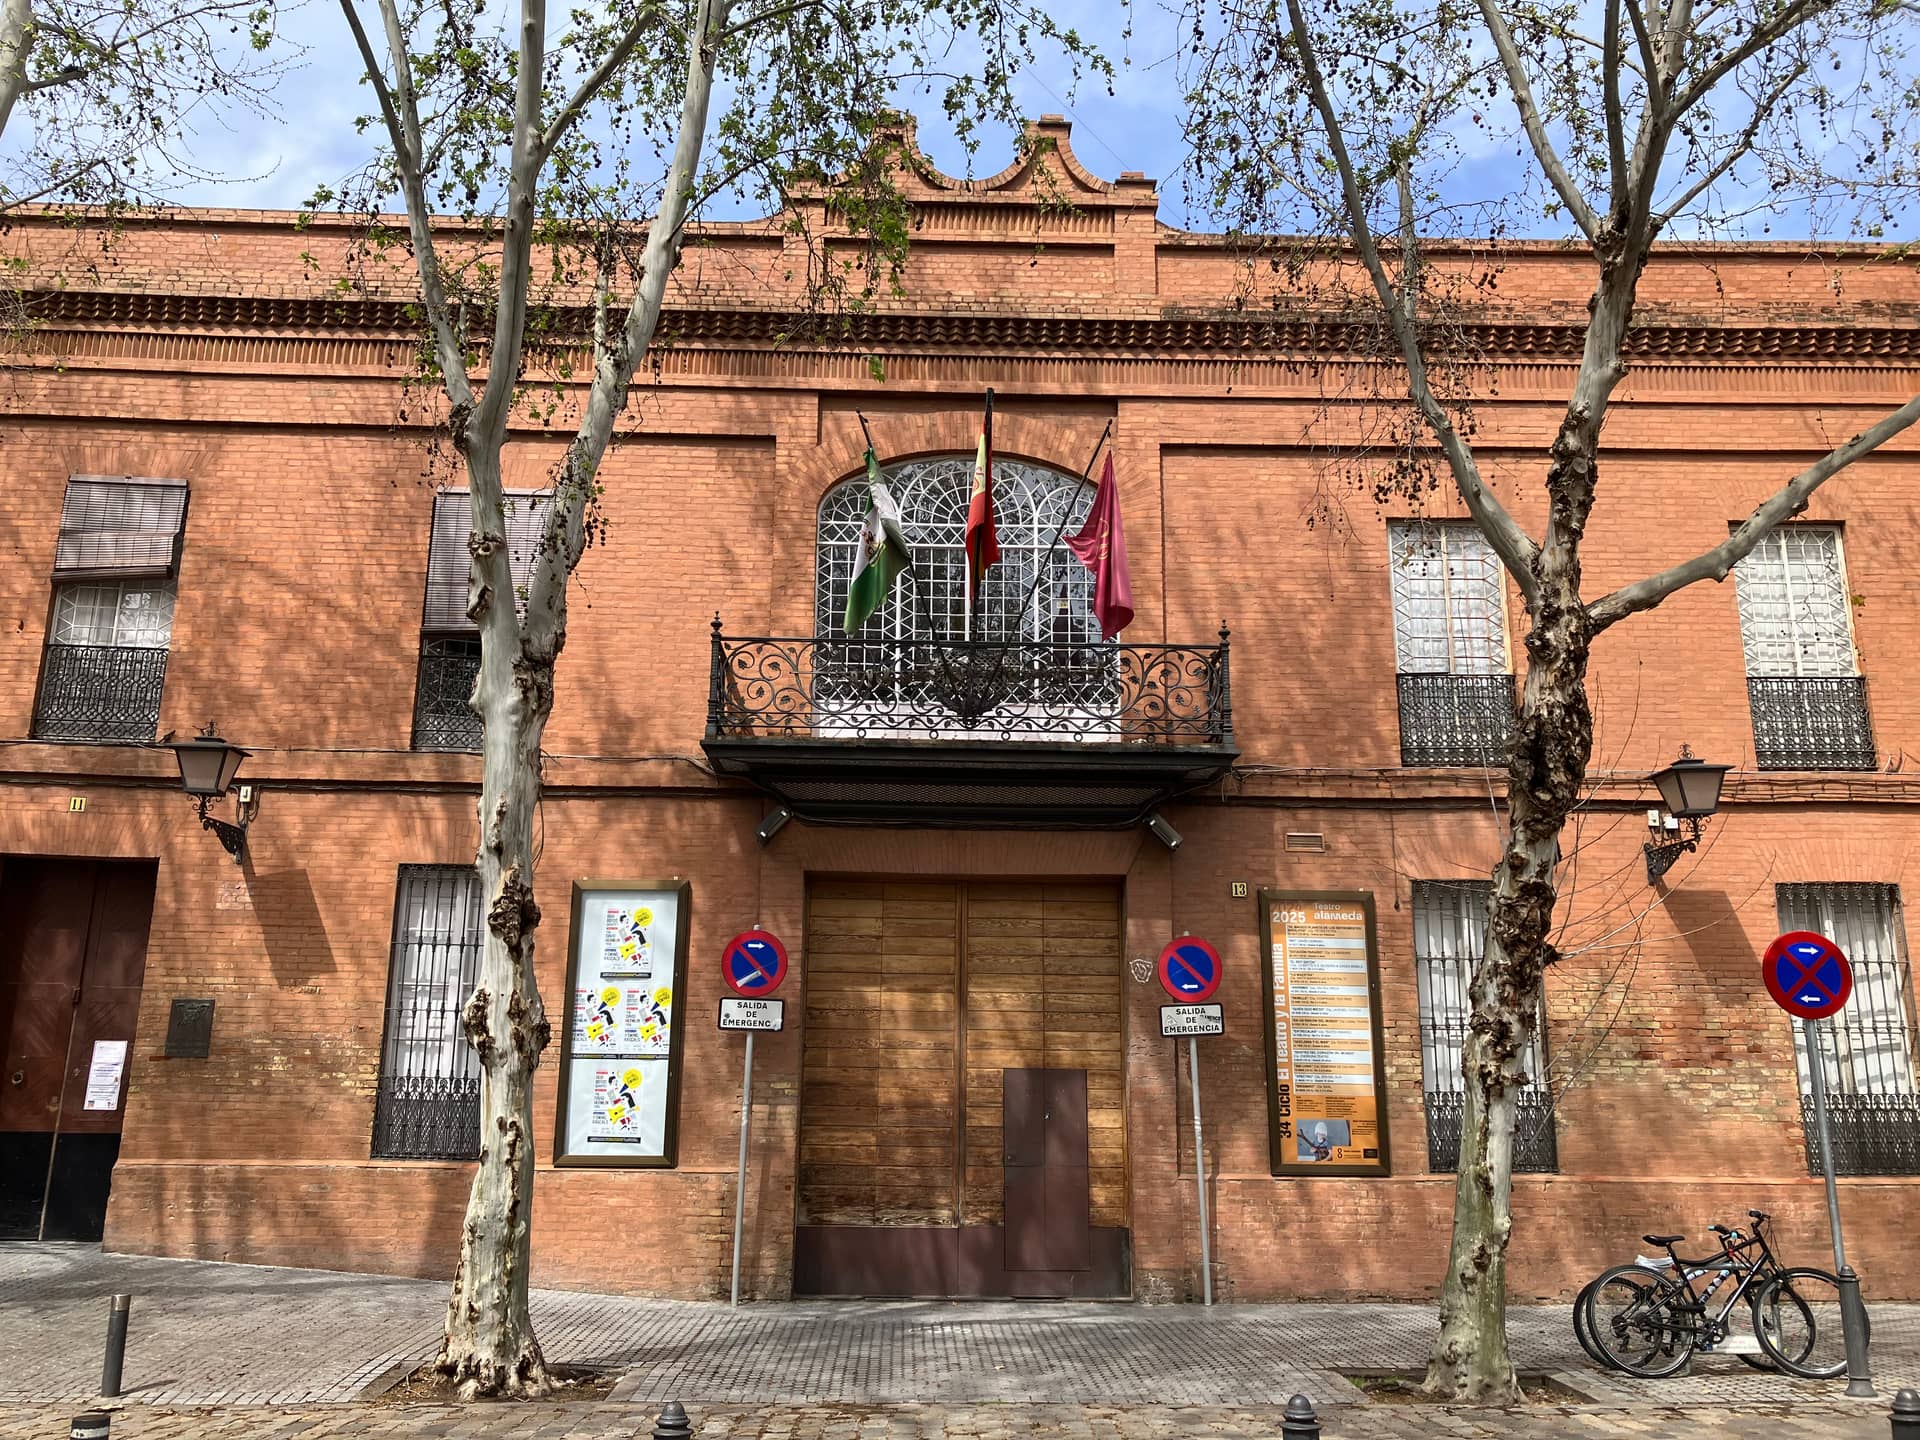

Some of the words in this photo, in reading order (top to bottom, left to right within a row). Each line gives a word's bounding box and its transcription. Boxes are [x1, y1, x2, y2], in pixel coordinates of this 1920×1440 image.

[72, 799, 83, 810] 11
[1234, 884, 1246, 895] 13
[1313, 902, 1341, 911] Teatro
[1272, 911, 1306, 923] 2025
[1313, 910, 1363, 921] alameda
[1271, 944, 1285, 990] Familia
[737, 1001, 768, 1010] SALIDA
[1273, 994, 1286, 1006] la
[1275, 1010, 1289, 1019] y
[722, 1019, 772, 1027] EMERGENC
[1164, 1024, 1220, 1033] EMERGENCIA
[1276, 1022, 1288, 1064] Teatro
[1277, 1069, 1289, 1080] El
[1279, 1085, 1291, 1117] Ciclo
[1279, 1121, 1291, 1139] 34
